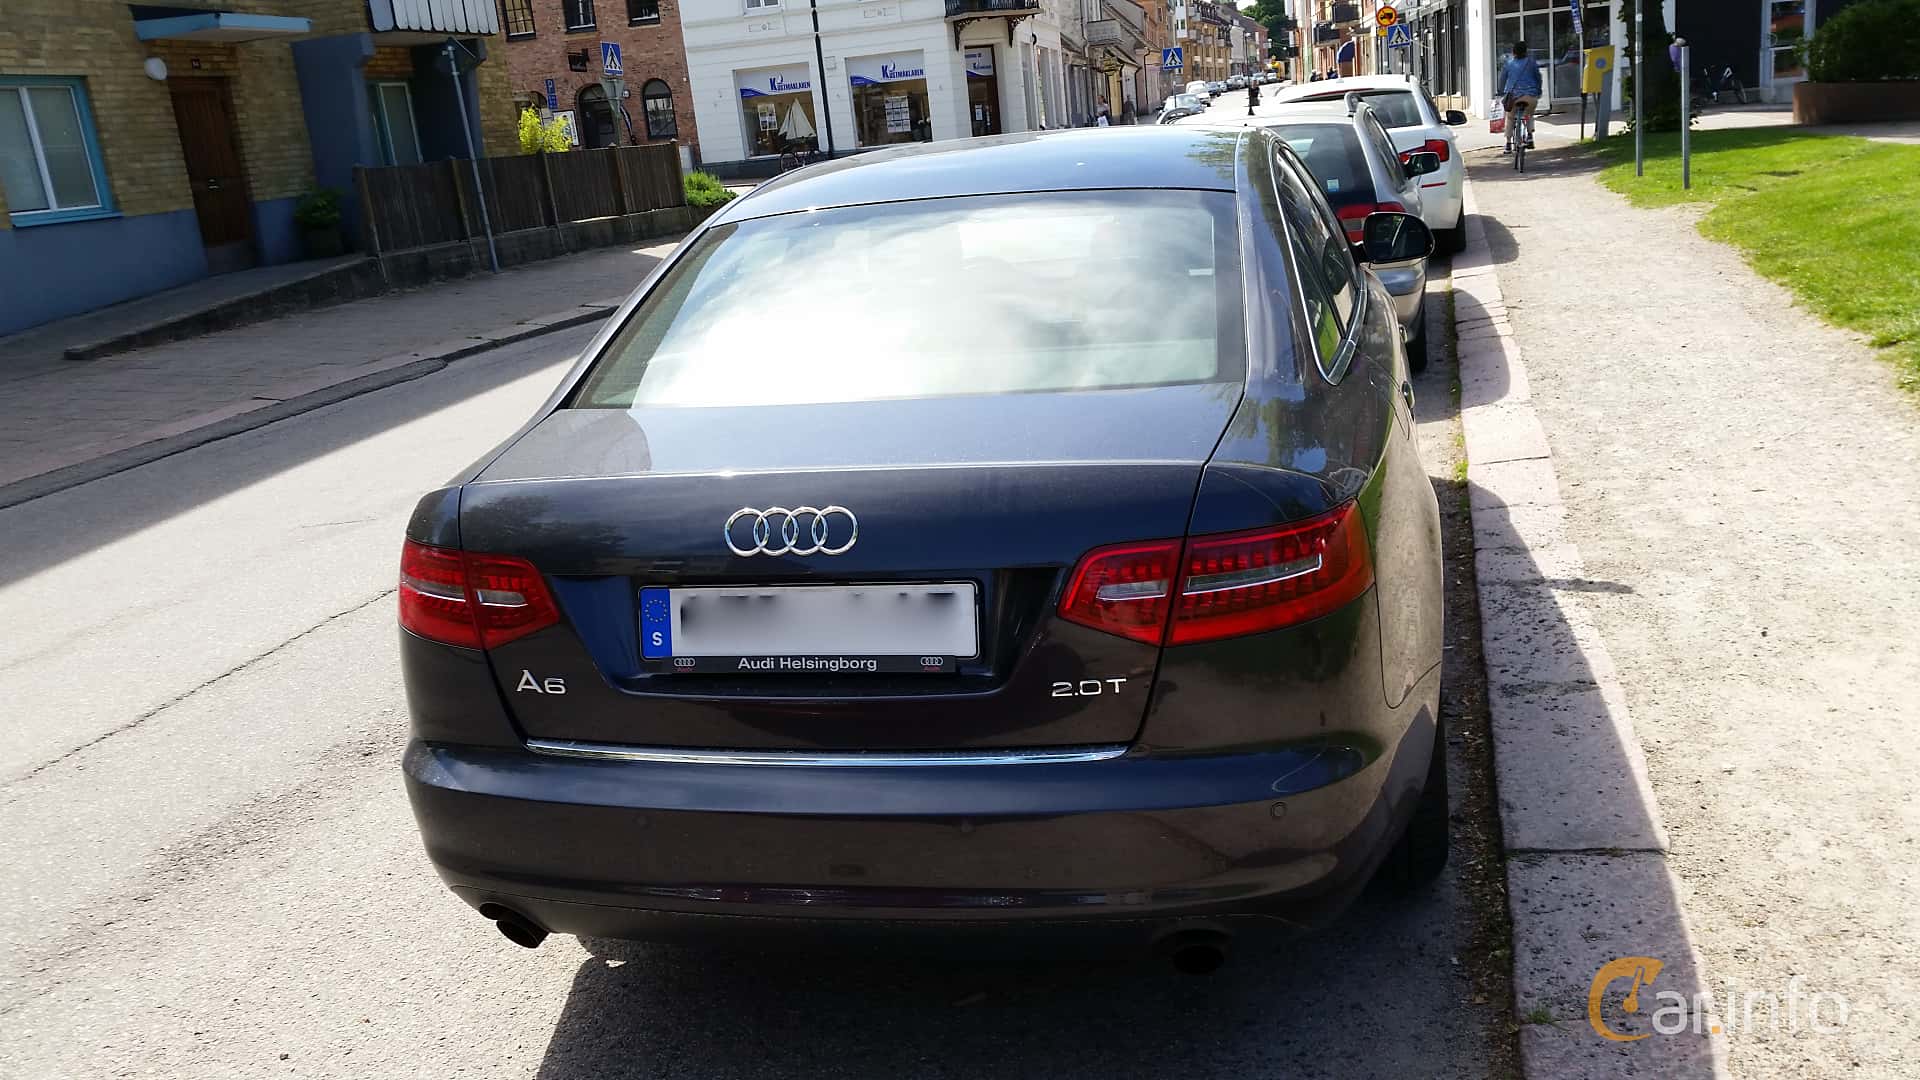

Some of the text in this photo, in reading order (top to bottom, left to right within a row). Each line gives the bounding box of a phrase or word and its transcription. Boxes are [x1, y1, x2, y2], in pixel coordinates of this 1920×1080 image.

[652, 631, 663, 646] S
[738, 656, 877, 672] Audi Helsingborg
[516, 669, 566, 694] A6
